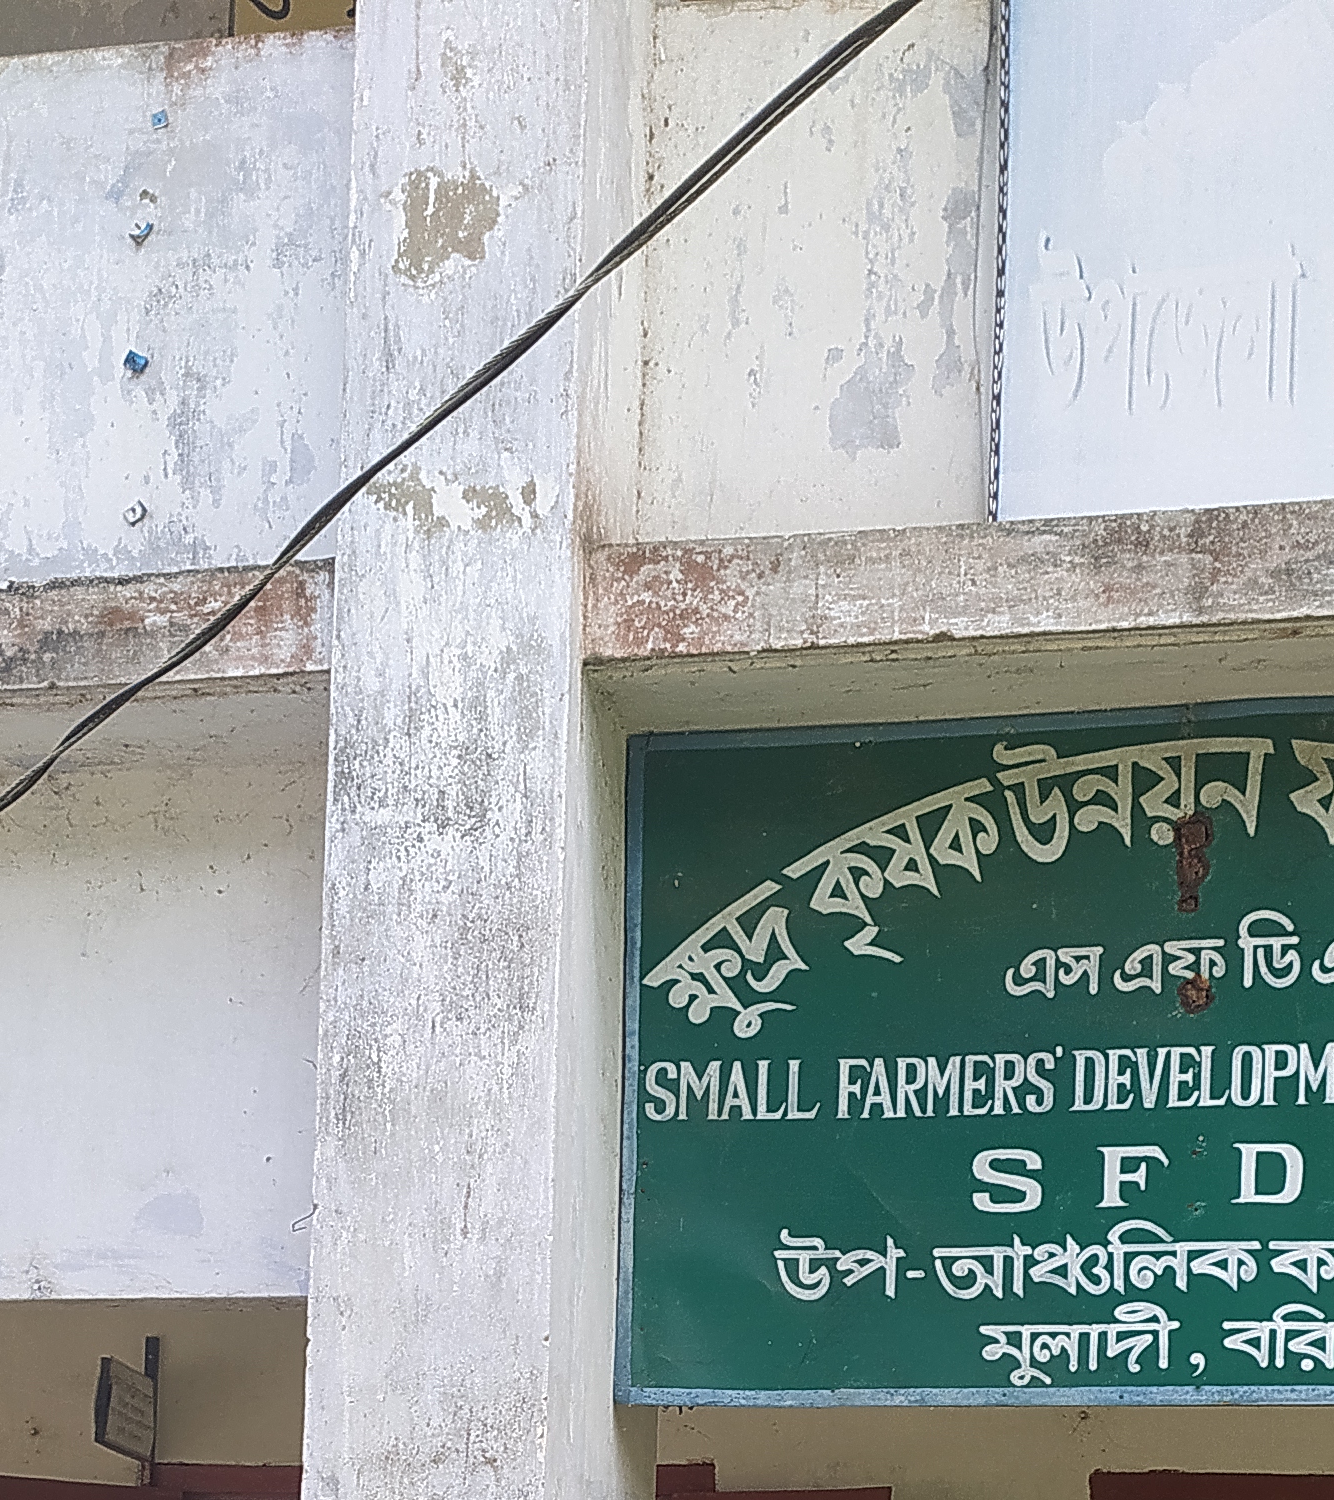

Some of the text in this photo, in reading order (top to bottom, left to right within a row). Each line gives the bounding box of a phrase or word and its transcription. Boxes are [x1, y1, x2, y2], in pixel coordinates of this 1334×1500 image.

[642, 878, 809, 1038] ক্ষুদ্র
[782, 777, 999, 963] কৃষক
[992, 737, 1274, 864] উন্নয়ন
[1004, 945, 1104, 998] এস
[1113, 937, 1227, 995] এফ
[1237, 908, 1301, 989] ডি
[644, 1060, 821, 1121] SMALL
[834, 1045, 1065, 1119] FARMERS'
